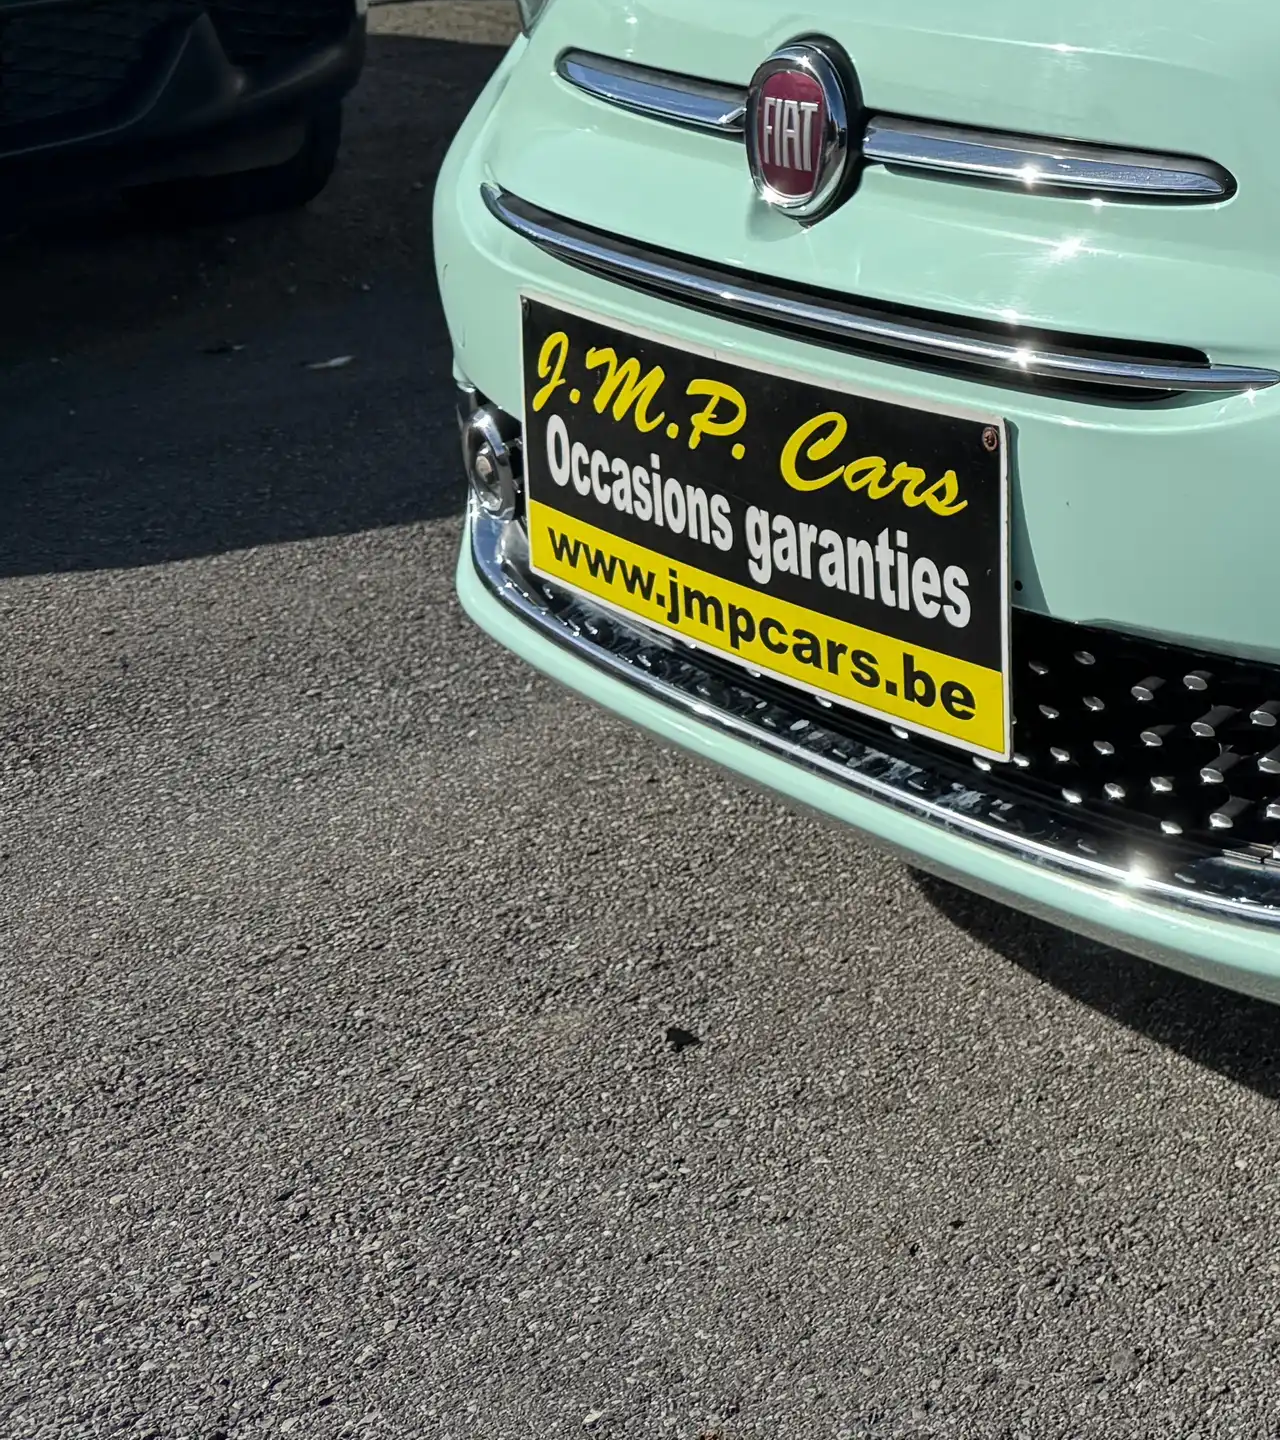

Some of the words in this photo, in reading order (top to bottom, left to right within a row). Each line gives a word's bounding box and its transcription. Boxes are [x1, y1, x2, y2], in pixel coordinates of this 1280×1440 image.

[763, 96, 820, 172] FIAT
[532, 331, 748, 460] J.M.P.
[780, 411, 969, 517] Cars
[546, 414, 734, 552] Occasions
[745, 526, 972, 629] garanties
[547, 526, 977, 721] www.jmpcars.be
